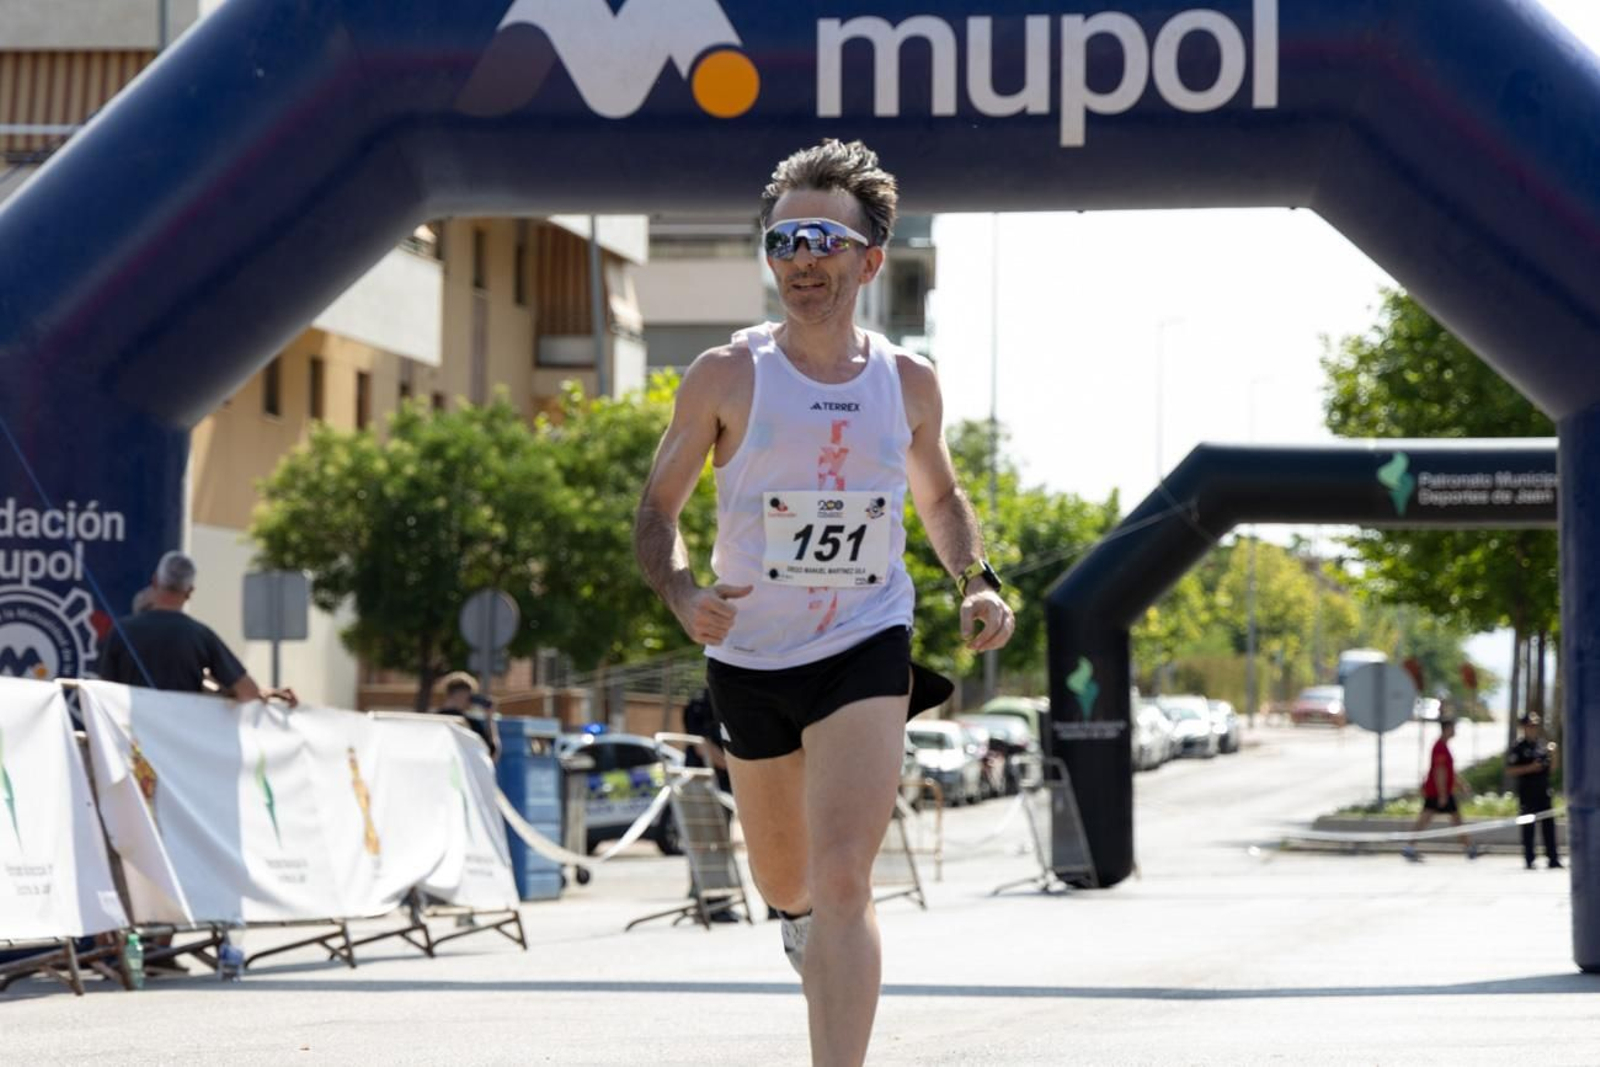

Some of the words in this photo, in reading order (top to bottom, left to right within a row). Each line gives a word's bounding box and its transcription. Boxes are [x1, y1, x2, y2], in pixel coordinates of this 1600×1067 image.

[816, 0, 1279, 147] mupol
[822, 402, 860, 411] TERREX
[1491, 489, 1513, 504] de
[0, 498, 125, 541] dación
[793, 524, 867, 562] 151
[0, 542, 84, 587] upol
